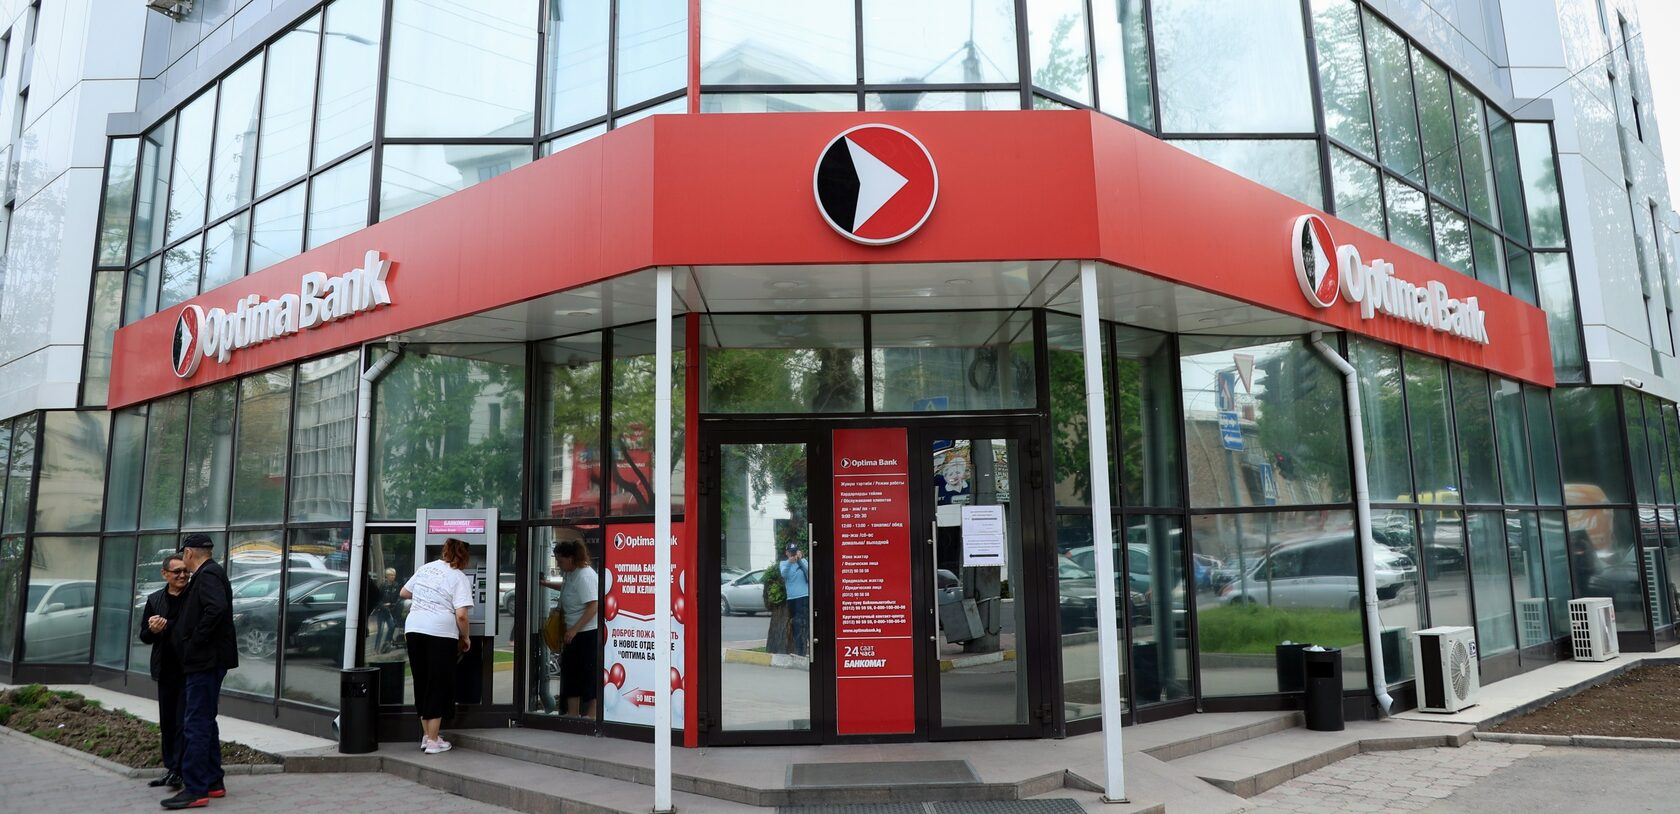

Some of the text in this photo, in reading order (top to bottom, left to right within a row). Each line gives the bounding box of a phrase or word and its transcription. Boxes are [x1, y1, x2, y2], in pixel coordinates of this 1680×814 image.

[1336, 244, 1489, 344] Optima Bank
[203, 250, 391, 363] Optima Bank
[626, 536, 654, 548] Optima
[617, 574, 637, 583] ЖАҢЫ
[612, 629, 634, 638] ДОБРОЕ
[619, 640, 638, 649] НОВОЕ
[844, 646, 859, 656] 24
[844, 659, 886, 668] БАНКОМАТ
